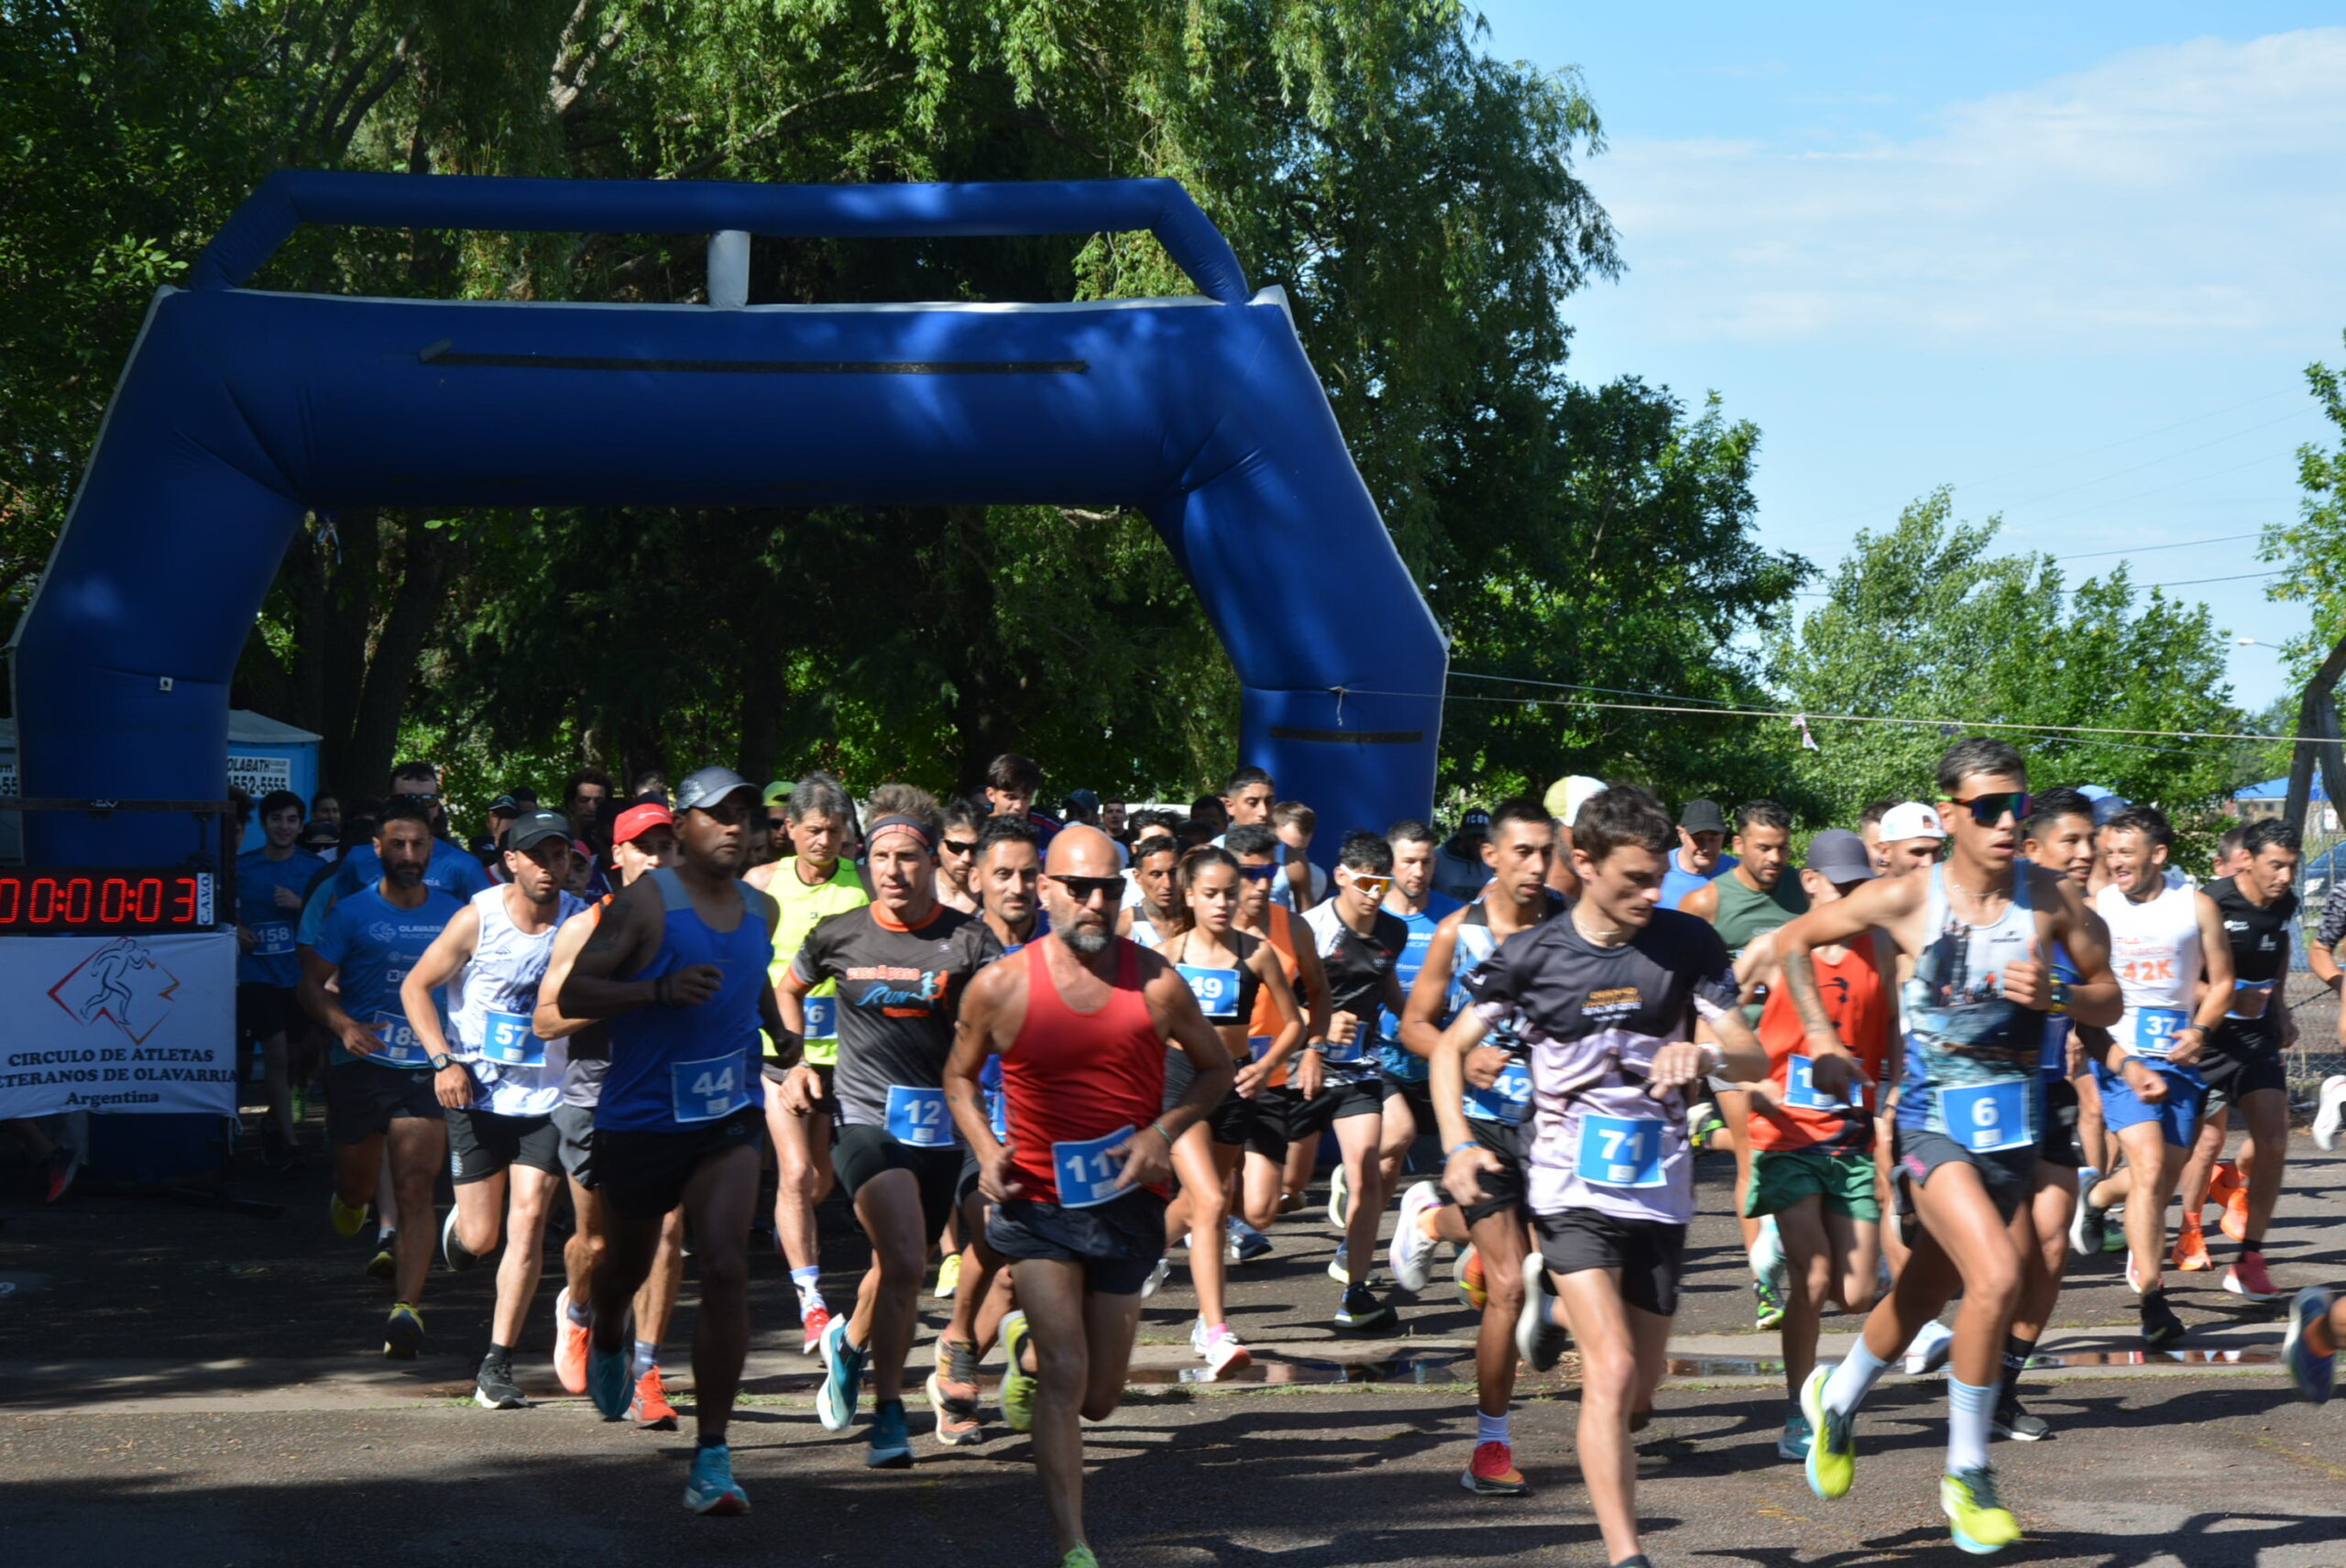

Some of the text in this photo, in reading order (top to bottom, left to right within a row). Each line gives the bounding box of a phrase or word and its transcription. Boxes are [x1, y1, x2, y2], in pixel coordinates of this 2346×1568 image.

[258, 927, 290, 942] 158
[2122, 959, 2175, 981] 42K
[1189, 976, 1223, 998] 49
[495, 1022, 532, 1047] 57
[2145, 1015, 2177, 1036] 37
[7, 1047, 214, 1067] CIRCULO DE ATLETAS
[103, 1068, 129, 1081] DE
[134, 1068, 236, 1083] OLAVARRIA
[691, 1067, 735, 1097] 44
[65, 1091, 160, 1108] Argentina
[1493, 1075, 1533, 1102] 42
[904, 1100, 941, 1125] 12
[1971, 1097, 2000, 1126] 6
[1598, 1128, 1645, 1161] 71
[1066, 1151, 1124, 1182] 11
